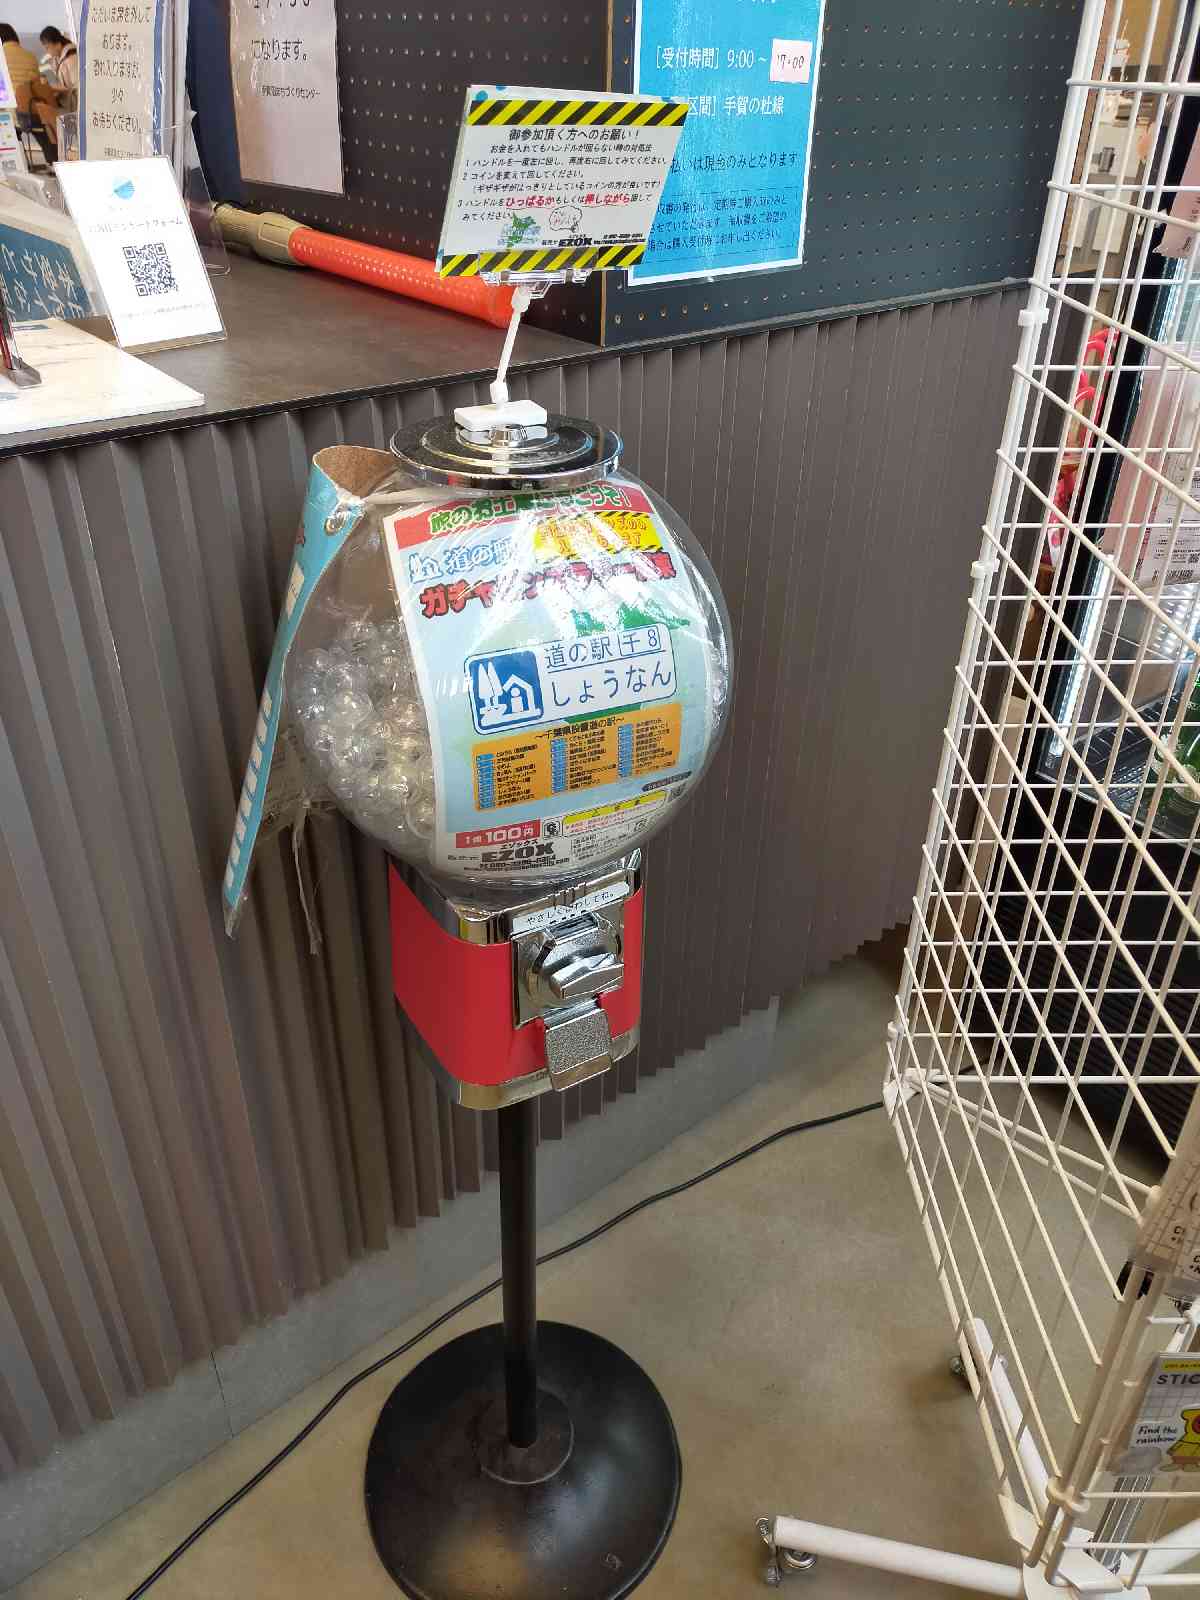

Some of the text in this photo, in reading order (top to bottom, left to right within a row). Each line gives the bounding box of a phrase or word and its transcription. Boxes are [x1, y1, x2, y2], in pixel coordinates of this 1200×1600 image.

[251, 38, 308, 61] になります。
[544, 637, 613, 669] 道の駅
[647, 629, 658, 647] 8
[551, 660, 672, 707] しょうなん
